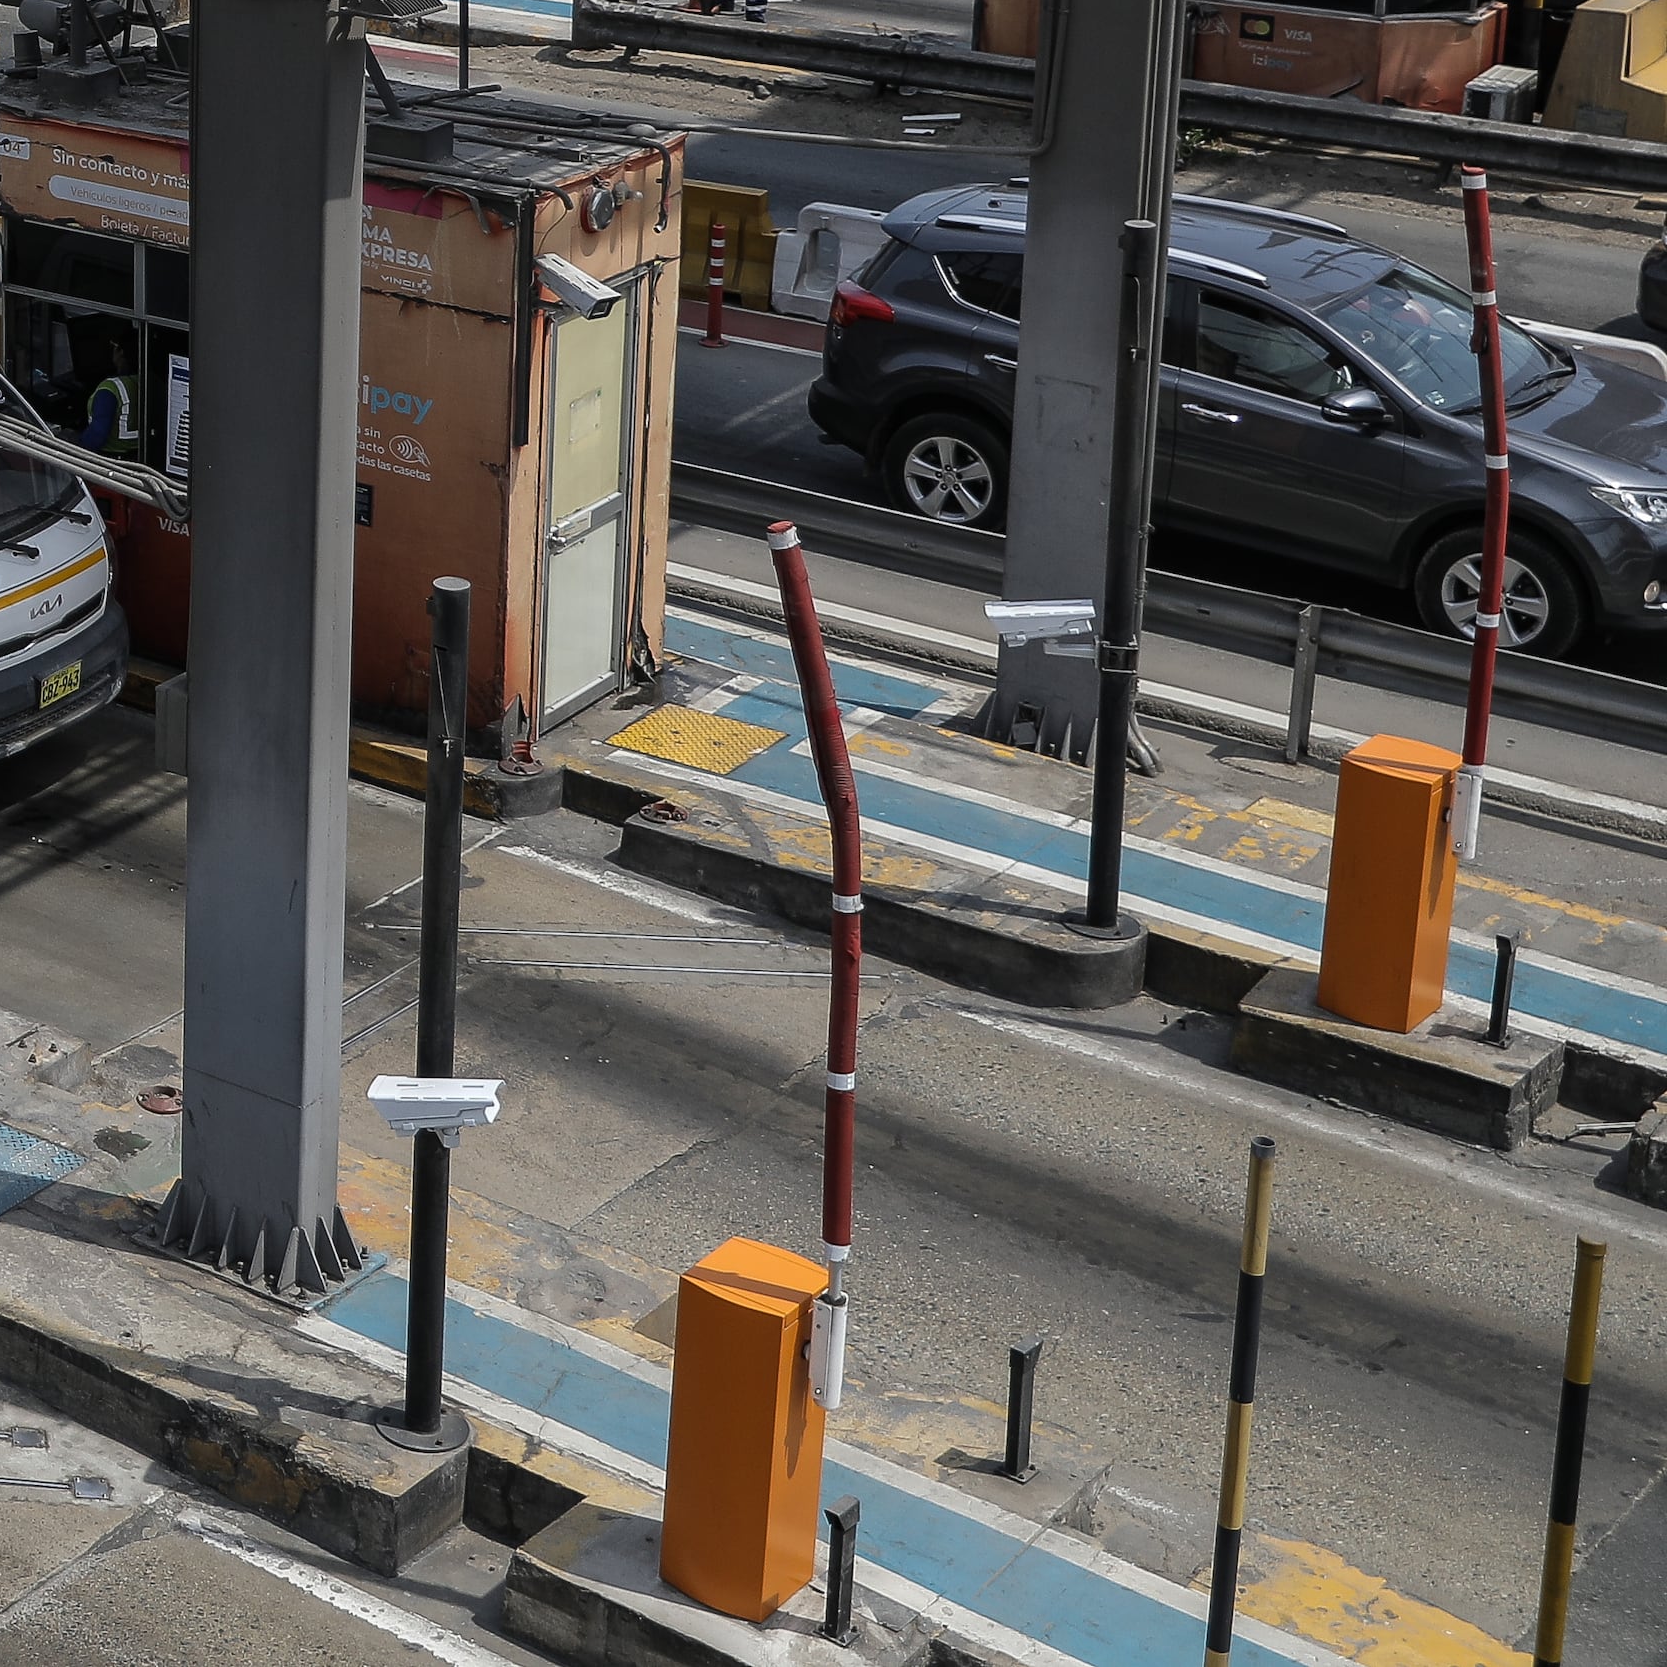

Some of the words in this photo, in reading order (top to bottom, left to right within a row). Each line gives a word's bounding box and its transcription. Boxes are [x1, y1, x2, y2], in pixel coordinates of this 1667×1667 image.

[1284, 29, 1313, 43] VISA
[52, 148, 75, 167] Sin
[78, 156, 147, 182] contacto
[150, 172, 160, 188] y
[380, 274, 416, 289] VINCI
[364, 426, 381, 439] sin
[377, 458, 392, 472] las
[392, 465, 432, 482] casetas
[157, 515, 190, 537] VISA
[42, 670, 80, 704] CBZ-943
